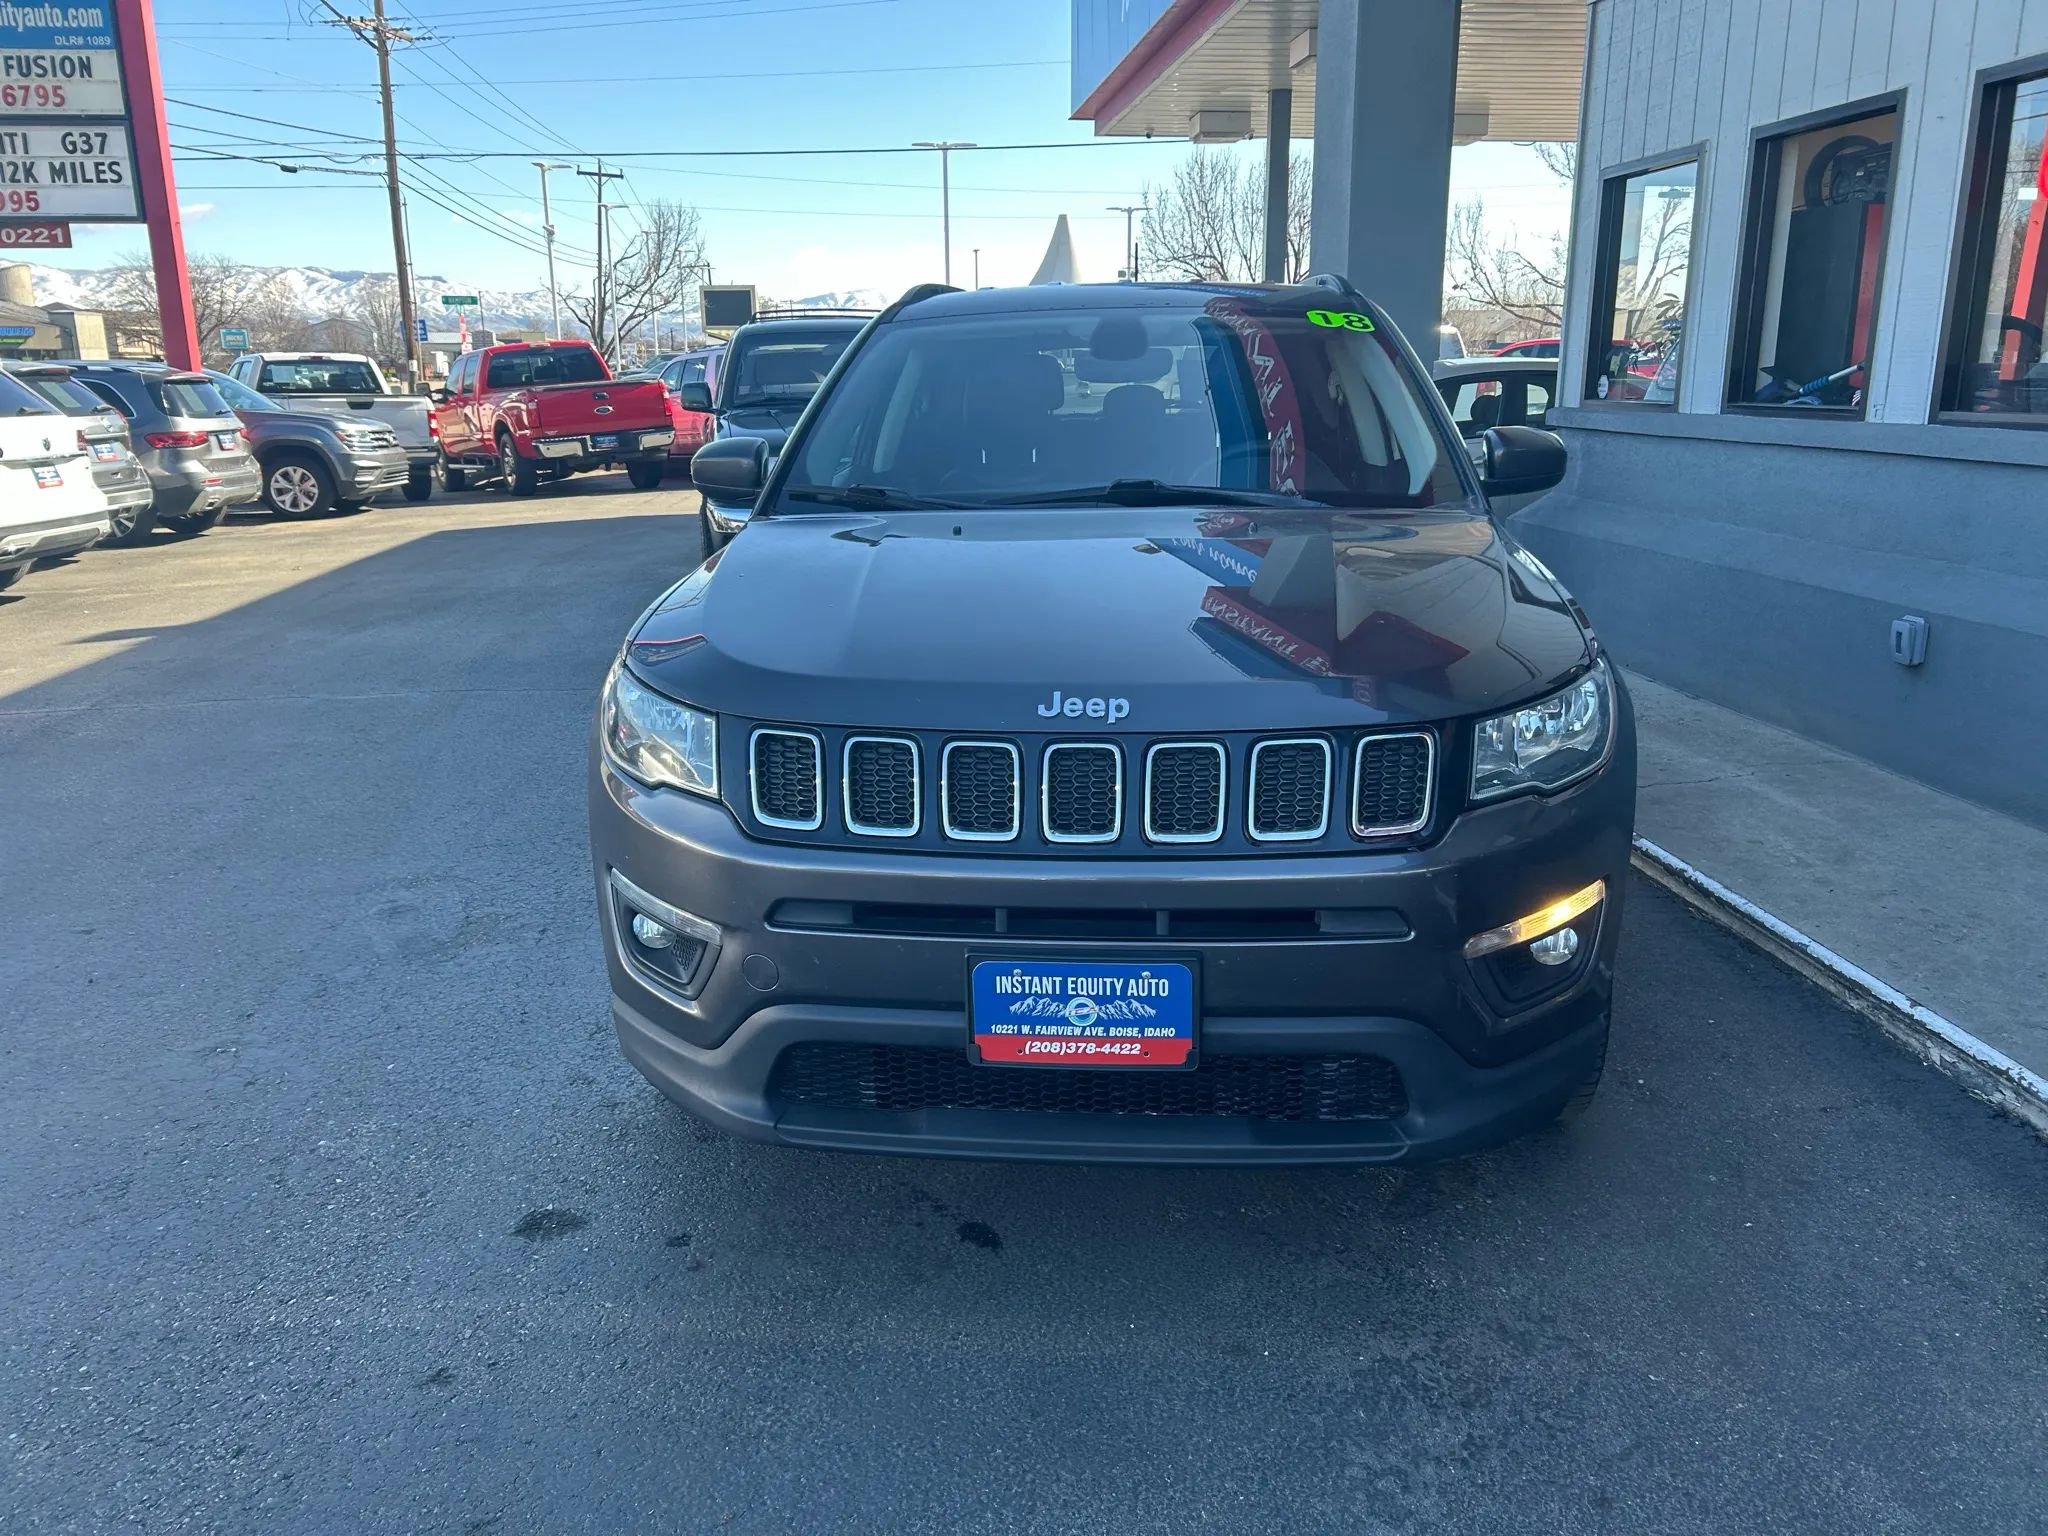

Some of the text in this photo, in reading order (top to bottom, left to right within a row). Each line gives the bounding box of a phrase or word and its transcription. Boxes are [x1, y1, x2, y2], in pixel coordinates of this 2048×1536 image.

[0, 1, 103, 32] ityauto.com
[54, 35, 111, 46] DLR# 1089
[3, 55, 93, 78] FUSION
[2, 84, 65, 107] 6795
[61, 132, 108, 154] G37
[48, 161, 123, 184] MILES
[1037, 691, 1130, 724] Jeep
[996, 976, 1169, 997] INSTANT EQUITY AUTO
[991, 1025, 1176, 1038] 10221 W. FAIRVIEW AVE. BOISE, IDAHO
[1025, 1041, 1141, 1055] (208)378-4422
